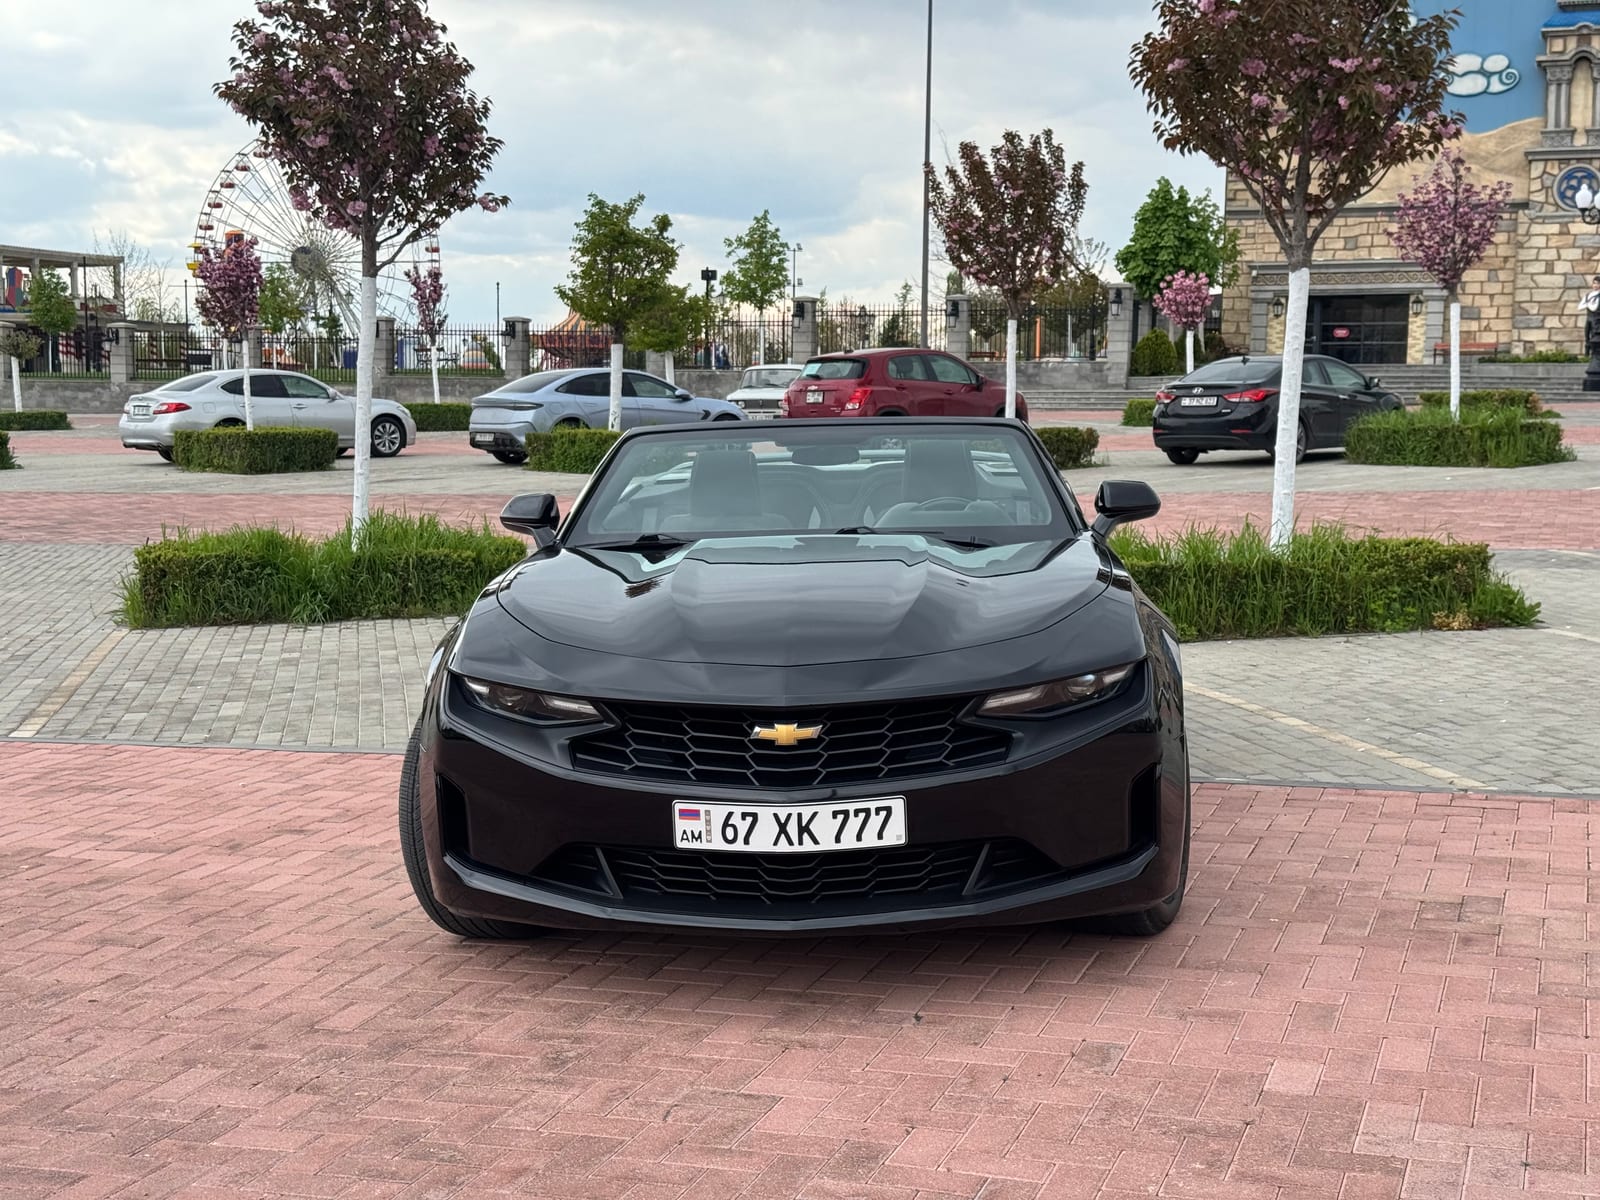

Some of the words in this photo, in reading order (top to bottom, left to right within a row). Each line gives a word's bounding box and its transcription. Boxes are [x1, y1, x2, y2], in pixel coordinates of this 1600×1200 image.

[680, 829, 702, 843] AM
[721, 811, 758, 845] 67
[773, 811, 820, 846] XK
[832, 806, 892, 844] 777
